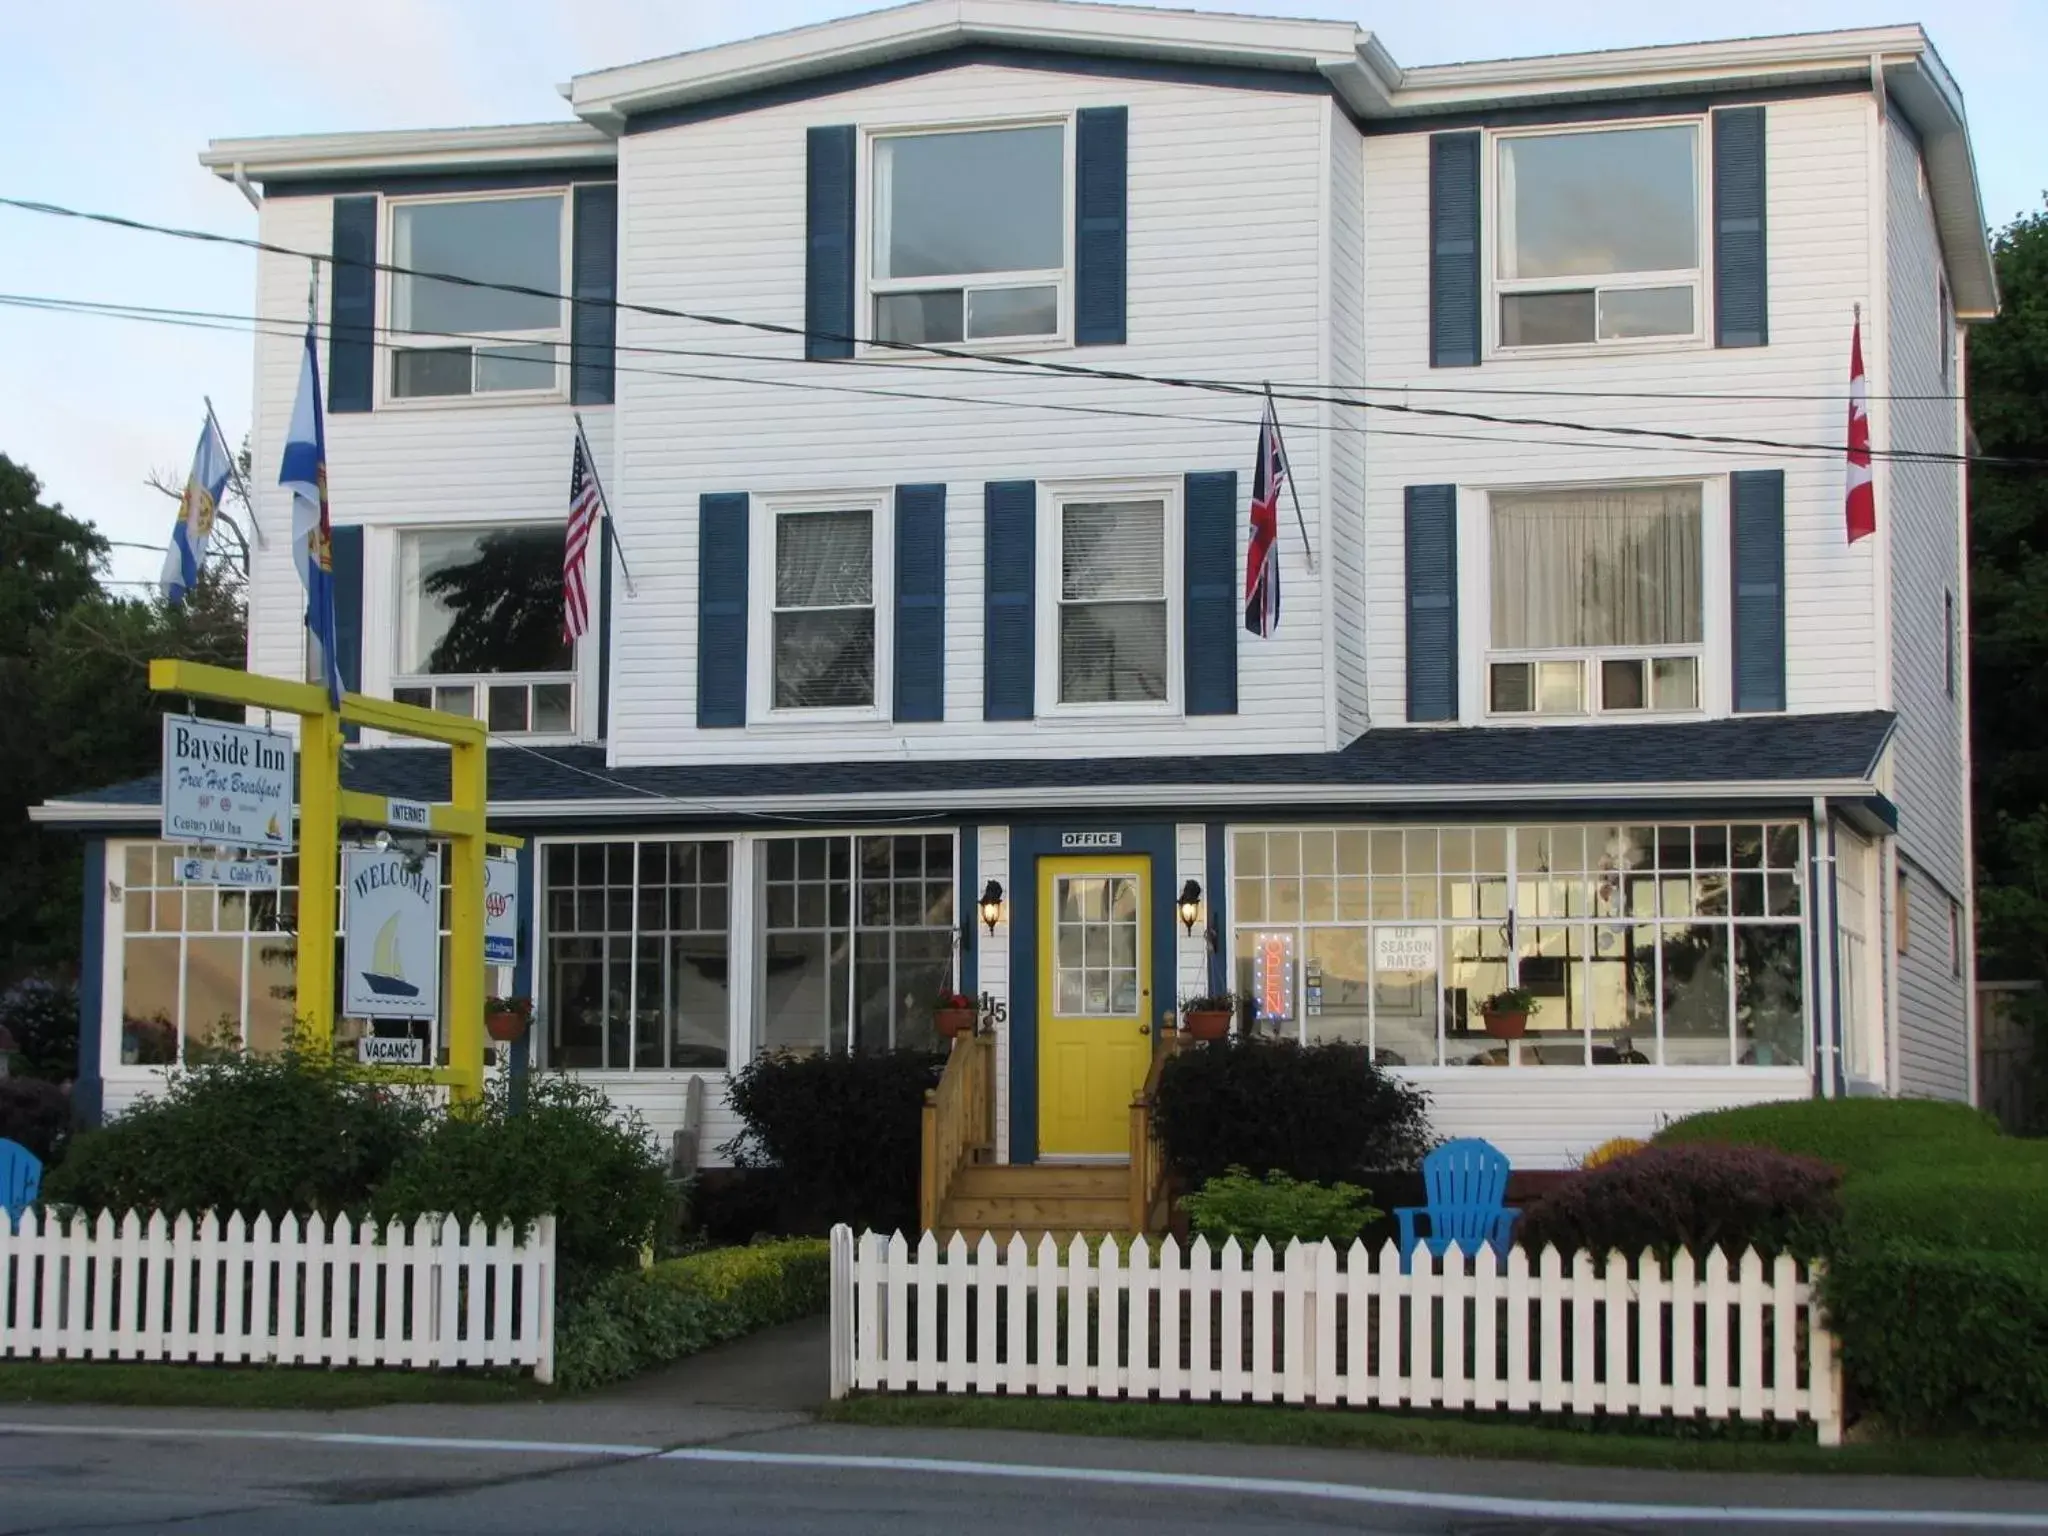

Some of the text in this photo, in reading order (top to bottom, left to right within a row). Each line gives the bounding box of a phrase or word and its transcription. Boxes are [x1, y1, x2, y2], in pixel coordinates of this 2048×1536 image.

[176, 727, 285, 772] Bayside Inn
[178, 766, 203, 790] Free
[204, 769, 228, 791] Hot
[231, 772, 282, 802] Breakfast
[391, 803, 426, 824] INTERNET
[173, 815, 241, 835] Century Old Inn
[1064, 833, 1118, 845] OFFICE
[229, 866, 253, 881] Cable
[353, 861, 432, 905] WELCOME
[1380, 940, 1432, 953] SEASON
[1386, 955, 1426, 968] RATES
[1266, 940, 1282, 1014] OPEN
[981, 991, 1007, 1023] 115
[365, 1042, 417, 1059] VACANCY
